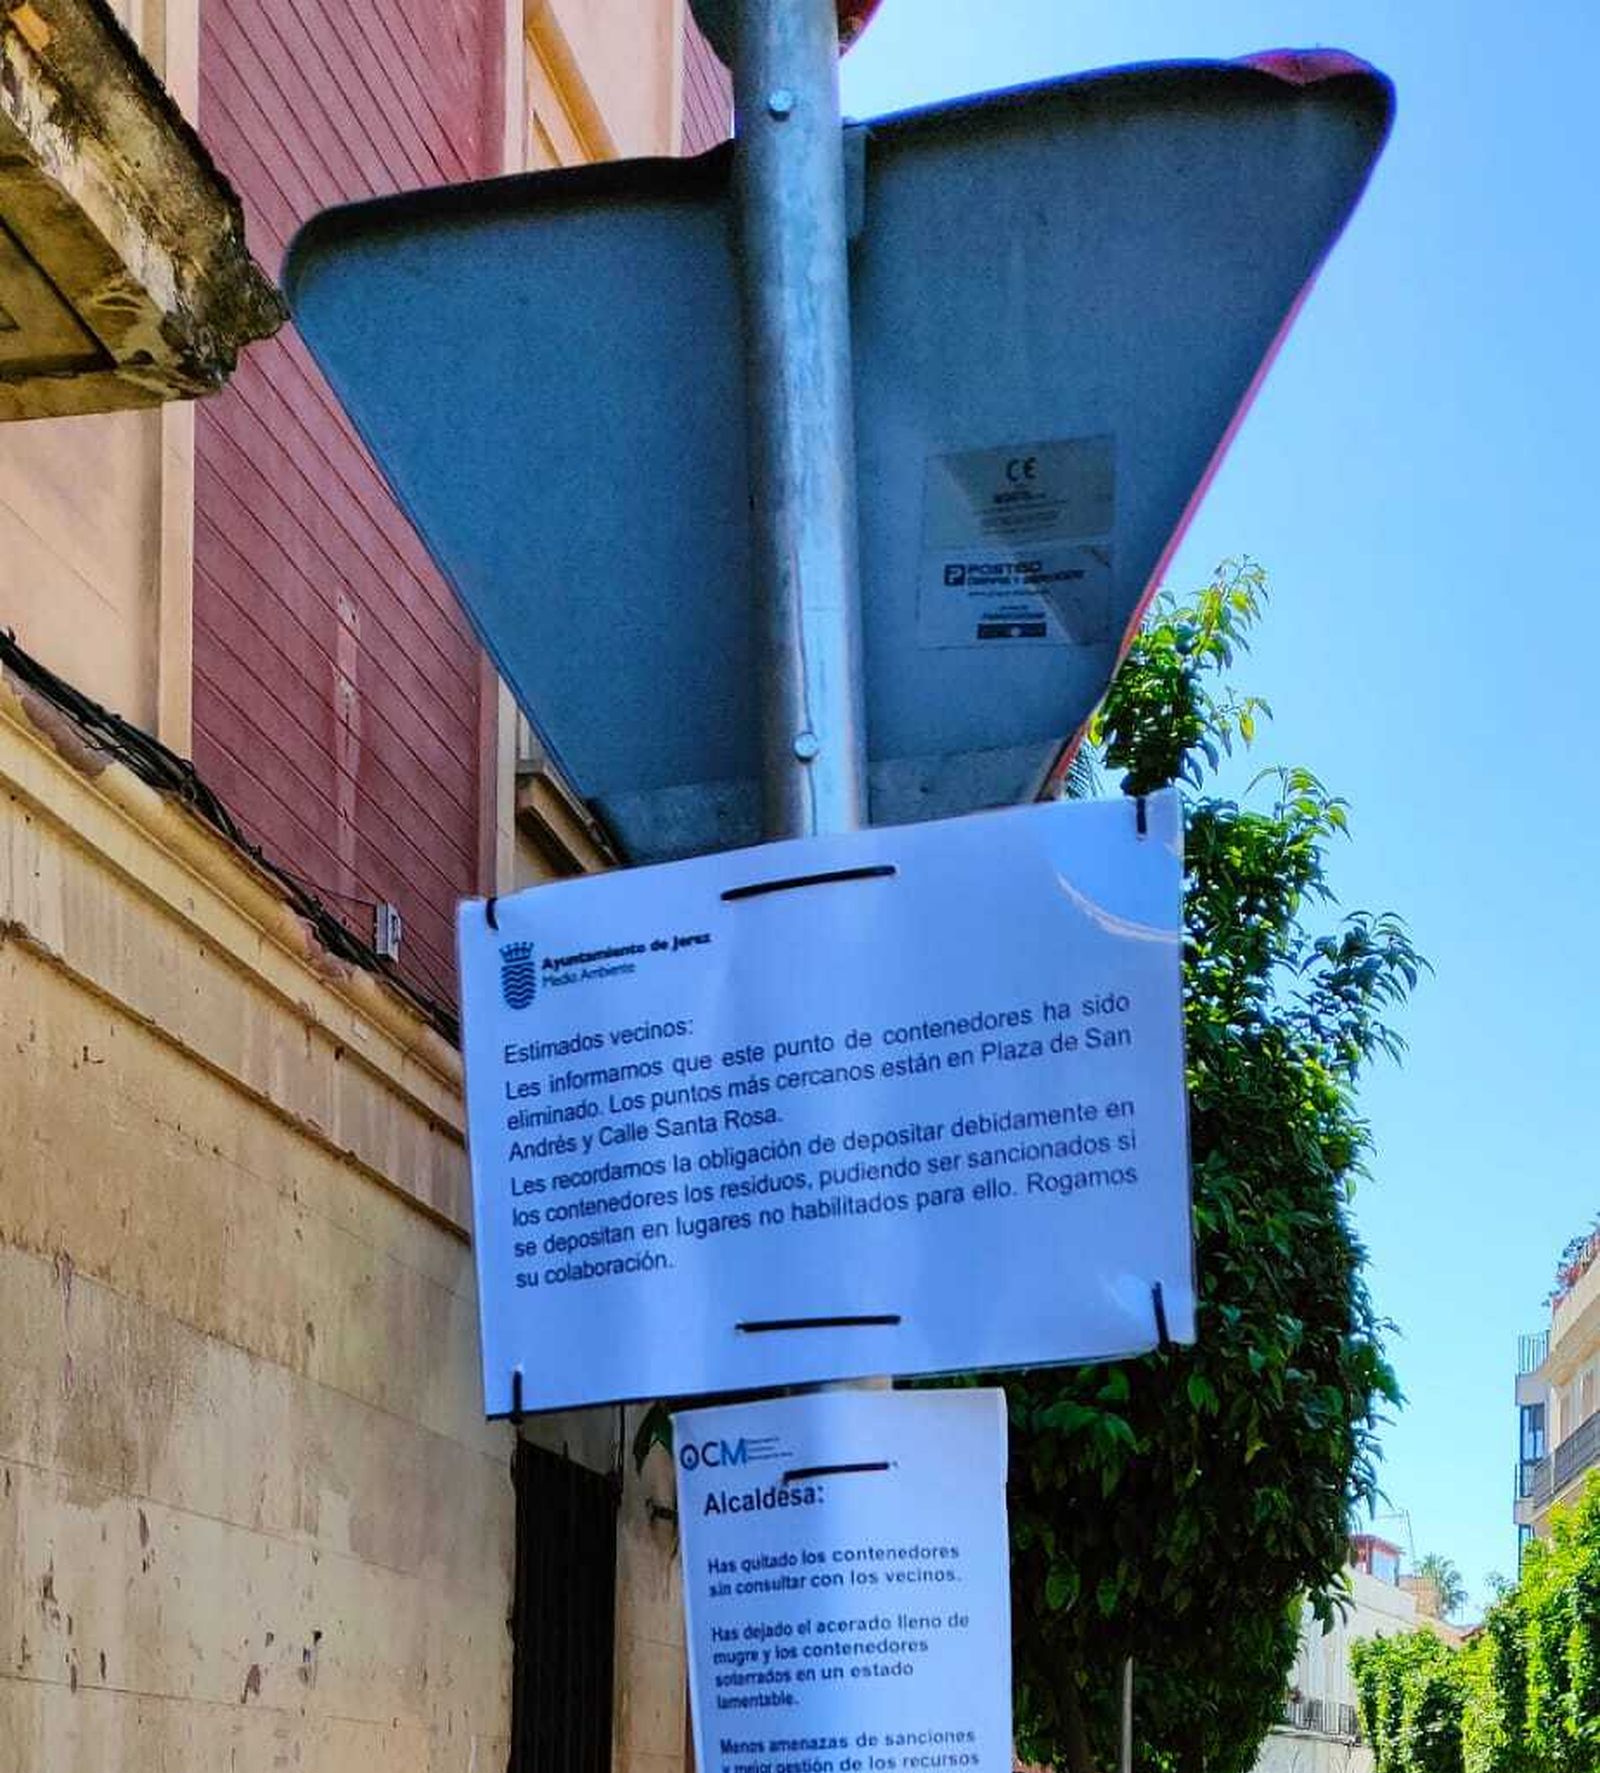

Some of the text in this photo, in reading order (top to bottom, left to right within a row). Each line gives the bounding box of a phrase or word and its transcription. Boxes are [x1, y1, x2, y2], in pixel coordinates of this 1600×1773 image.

[541, 932, 712, 971] Ayuntamiento de Jerez
[504, 1018, 694, 1066] Estimados vecinos:
[505, 992, 1131, 1102] Les informamos que este punto de contenedores ha sido
[506, 1026, 1132, 1132] eliminado. Los puntos más cercanos están en Plaza de San
[508, 1106, 783, 1163] Andrés y Calle Santa Rosa.
[510, 1100, 1135, 1198] Les recordamos la obligación de depositar debidamente en
[512, 1131, 1136, 1228] los contenedores los residuos, pudiendo ser sancionados si
[513, 1166, 1138, 1259] se depositan en lugares no habilitados para ello. Rogamos
[515, 1249, 673, 1290] su colaboración.
[680, 1437, 748, 1471] OCM
[703, 1484, 825, 1517] Alcaldesa:
[708, 1543, 960, 1576] Has quitado los contenedores
[708, 1566, 962, 1600] sin consultar con los vecinos.
[710, 1611, 970, 1645] Has dejado el acerado lleno de
[712, 1635, 929, 1669] mugre y los contenedores
[794, 1667, 817, 1684] en
[819, 1665, 845, 1682] un
[849, 1659, 915, 1680] estado
[715, 1688, 800, 1711] lamentable.
[718, 1729, 976, 1757] Menos amenazas de sanciones
[839, 1756, 863, 1773] de
[868, 1754, 897, 1771] los
[902, 1752, 981, 1769] recursos
